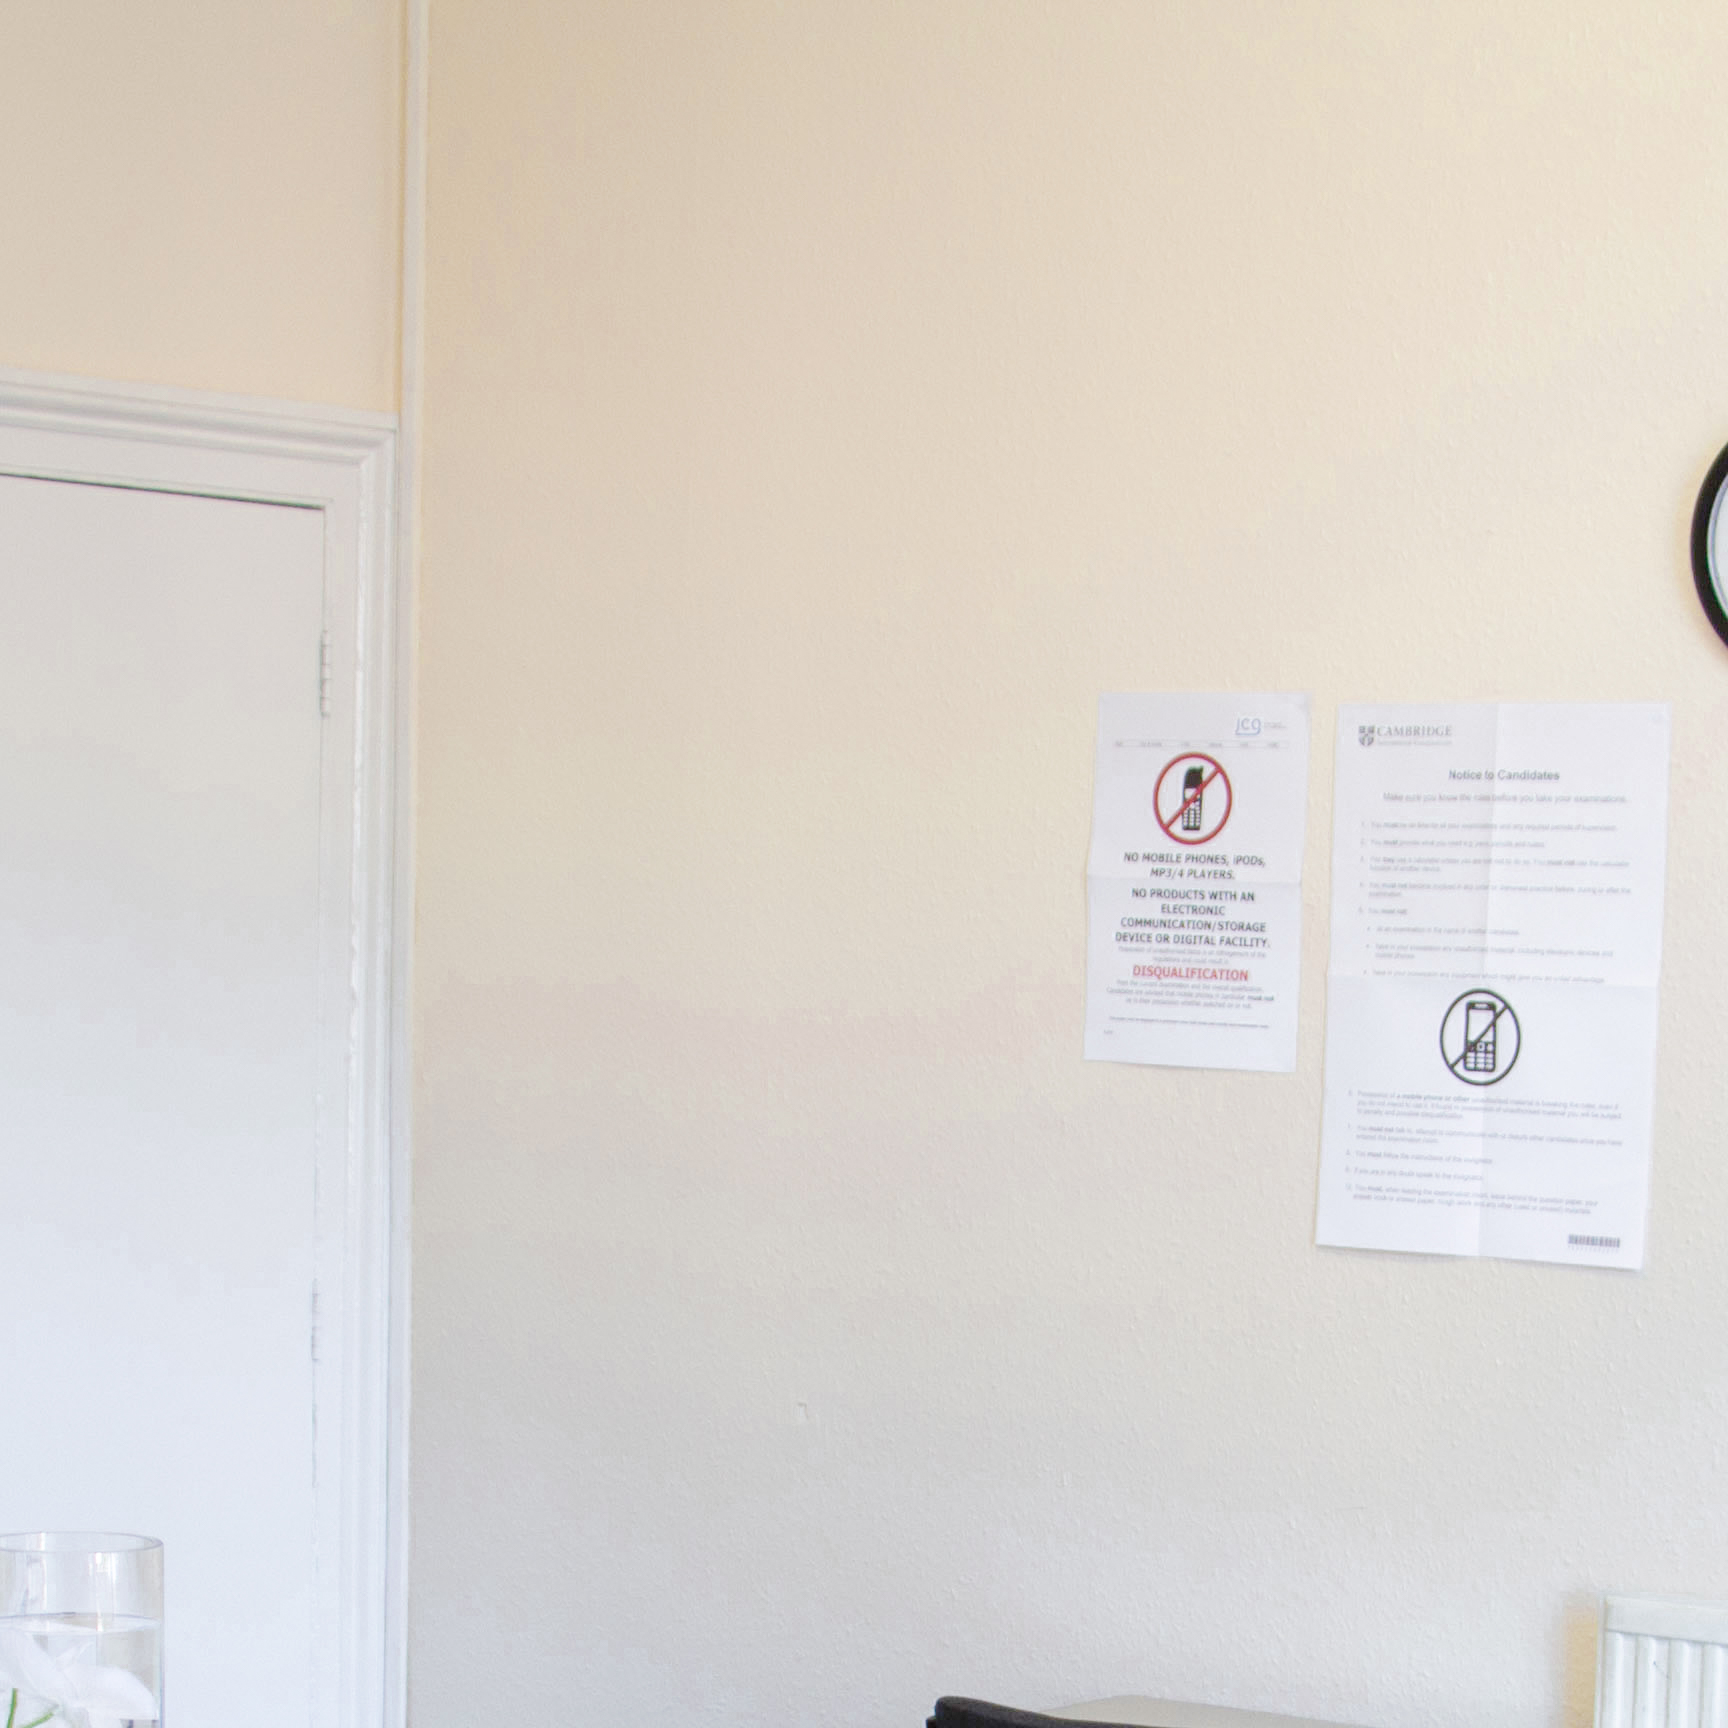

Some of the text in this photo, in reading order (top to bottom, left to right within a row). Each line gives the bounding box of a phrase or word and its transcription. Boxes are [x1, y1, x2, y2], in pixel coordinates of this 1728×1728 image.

[1377, 725, 1453, 737] CAMBRIDGE
[1448, 768, 1561, 782] Notice to Candidates
[1124, 852, 1266, 868] NO MOBILE PHONES, iPODs,
[1150, 867, 1236, 880] MP3/4 PLAYERS.
[1132, 888, 1255, 902] NO PRODUCTS WITH AN
[1160, 903, 1226, 916] ELECTRONIC
[1120, 917, 1267, 933] COMMUNICATION/STORAGE
[1115, 931, 1270, 949] DEVICE OR DIGITAL FACILITY.
[1132, 964, 1250, 982] DISQUALIFICATION
